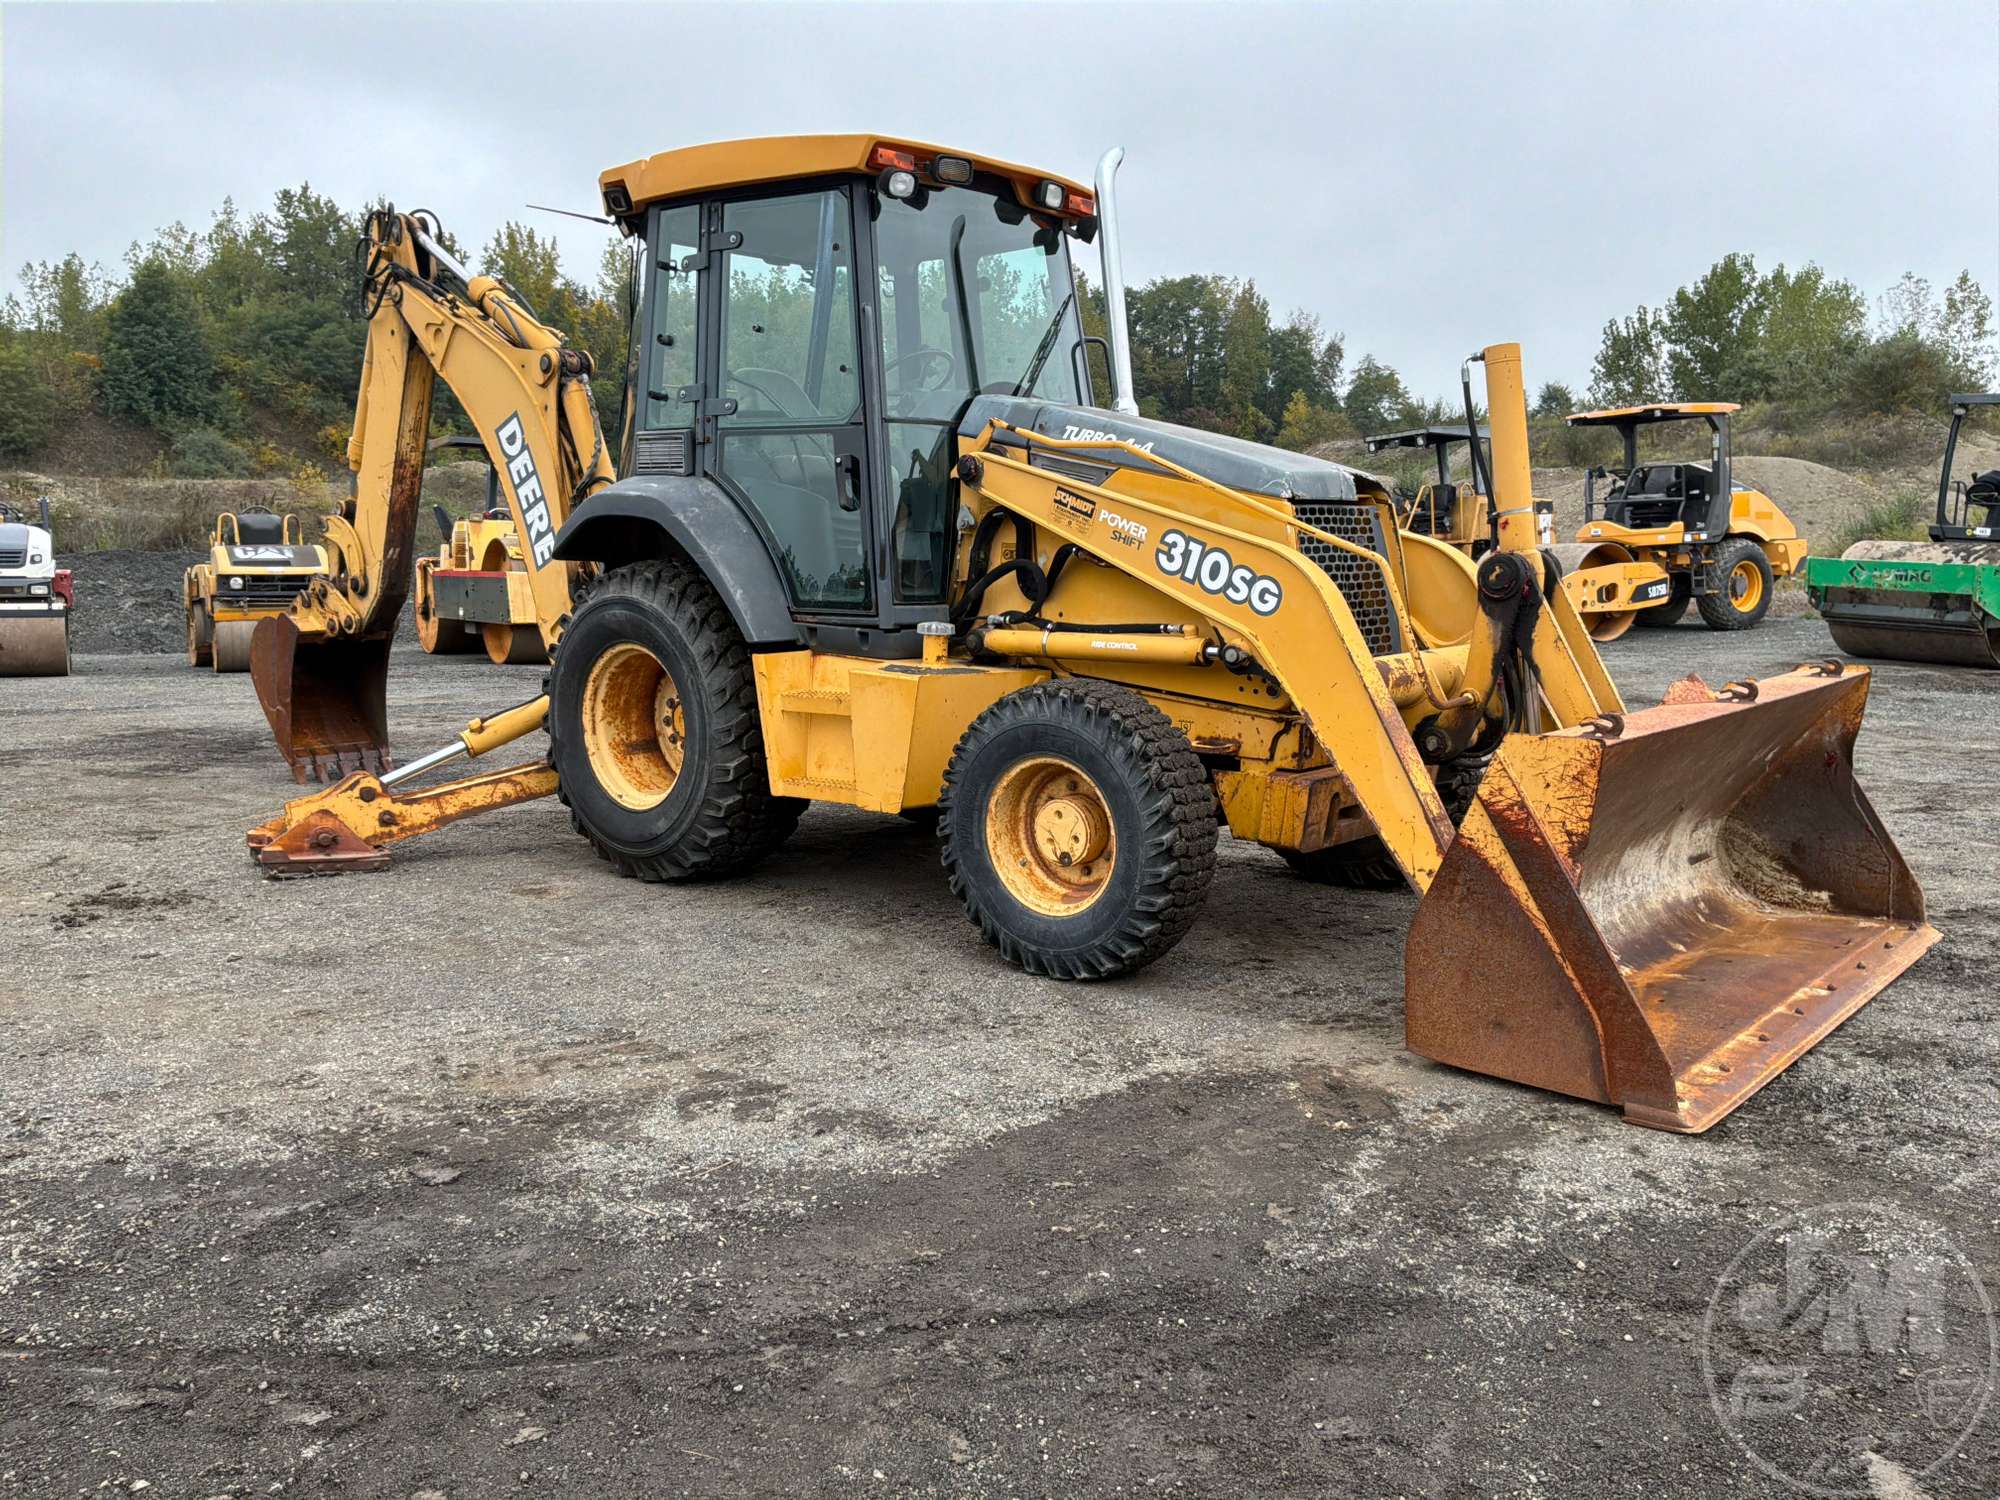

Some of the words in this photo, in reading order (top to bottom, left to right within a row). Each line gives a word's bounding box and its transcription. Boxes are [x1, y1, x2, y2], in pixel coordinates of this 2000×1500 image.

[1062, 425, 1117, 442] TURBO
[497, 415, 555, 569] DEERE
[1054, 488, 1095, 515] SCHMIDT
[1099, 509, 1148, 539] POWER
[1110, 530, 1145, 550] SHIFT
[232, 546, 295, 559] CAT
[1156, 530, 1281, 615] 310SG
[1872, 568, 1932, 583] MAG
[1106, 640, 1138, 651] CONTROL
